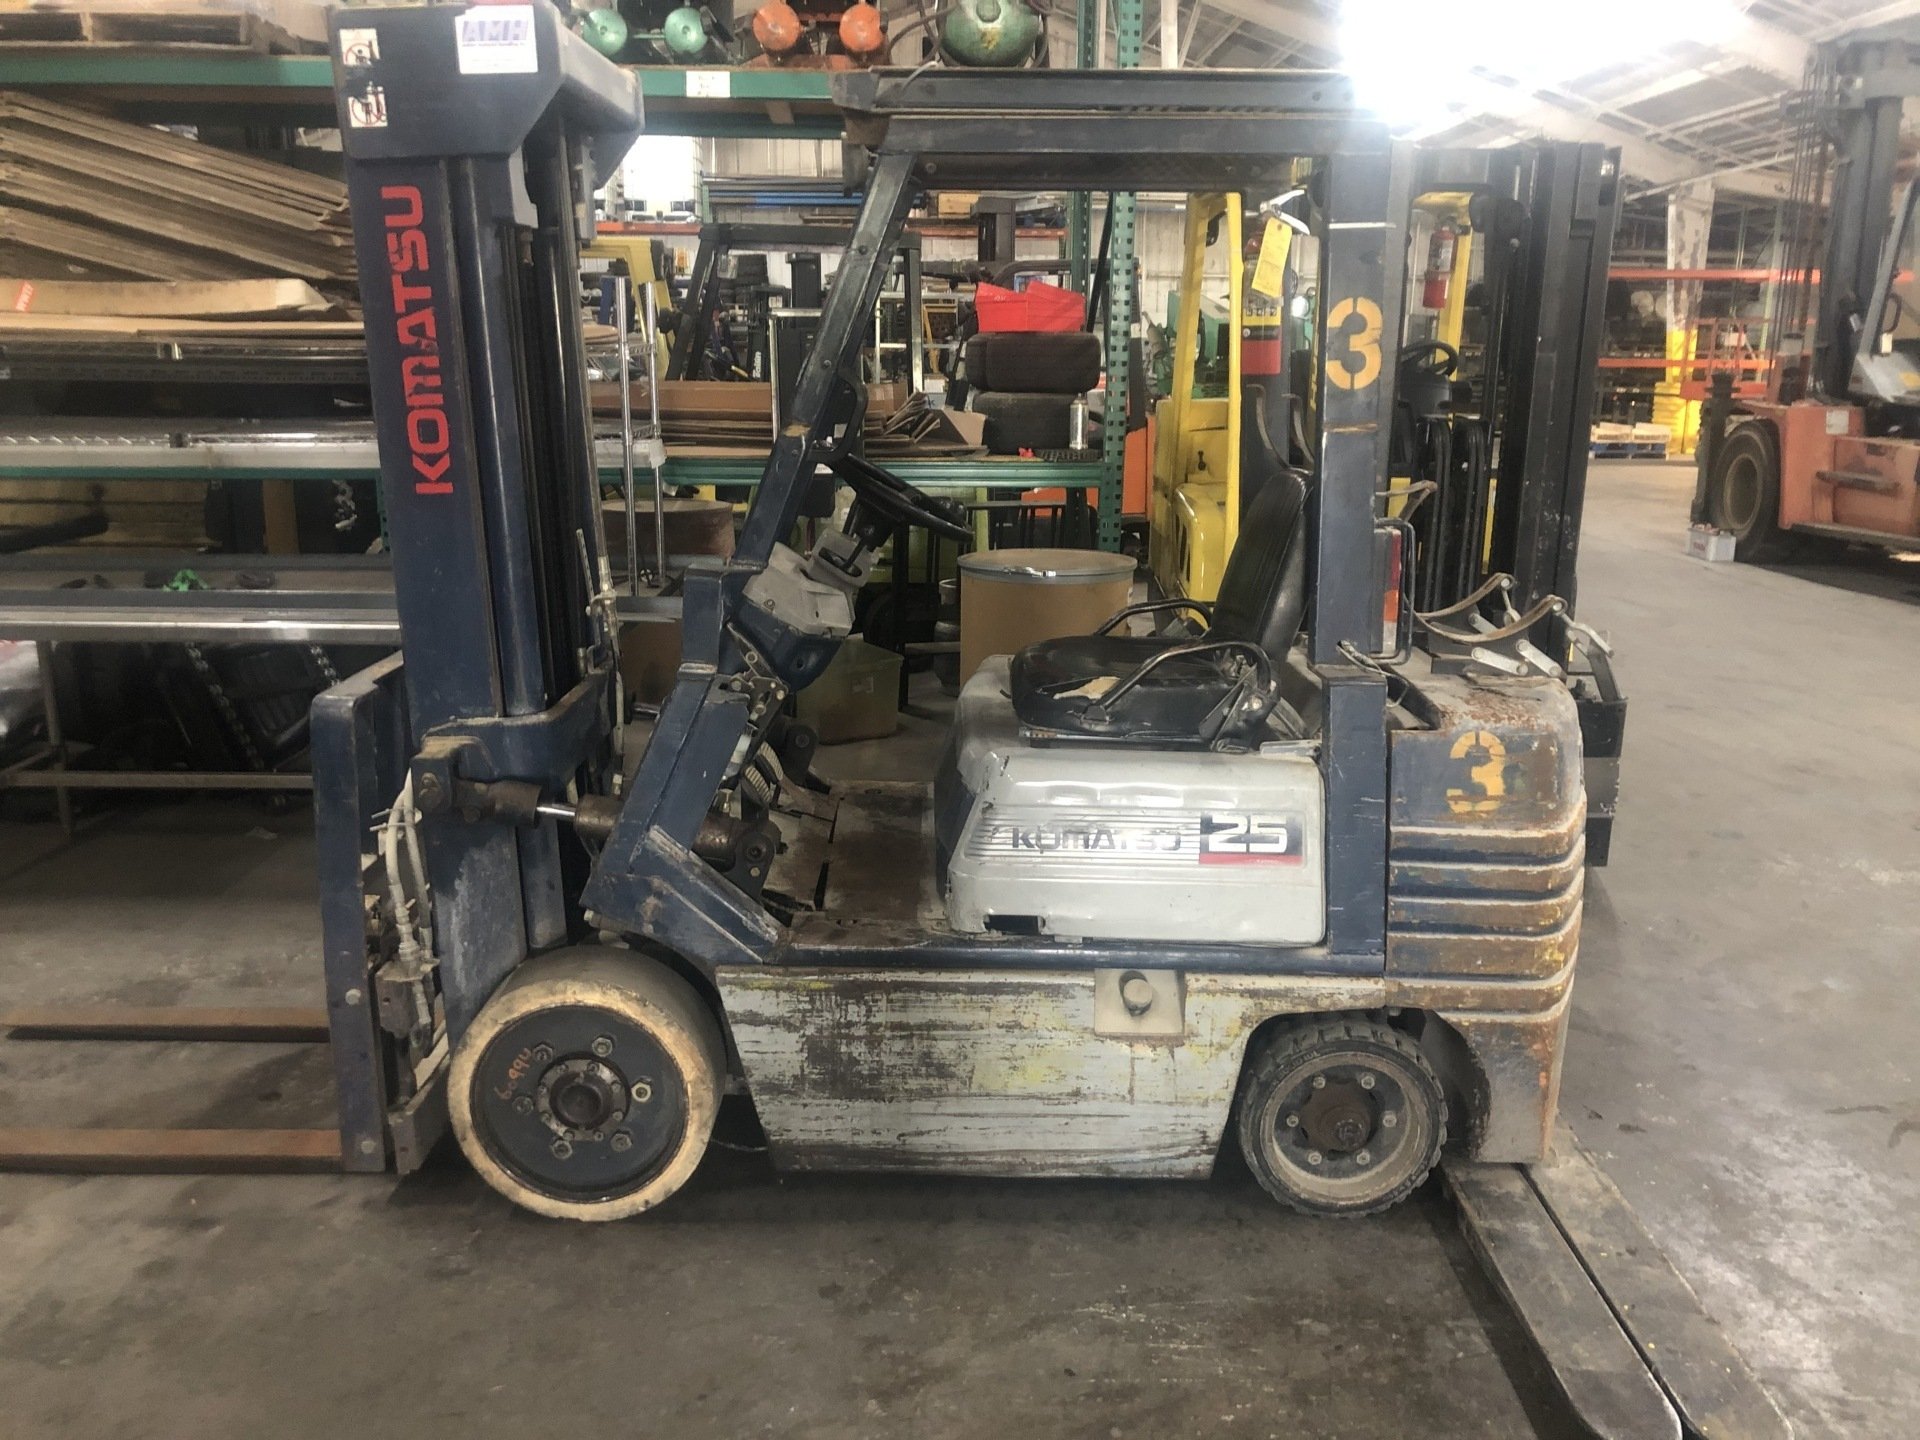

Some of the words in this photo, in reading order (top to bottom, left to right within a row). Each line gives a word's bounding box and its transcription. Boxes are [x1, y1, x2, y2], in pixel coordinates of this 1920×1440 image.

[380, 184, 454, 495] KOMATSU
[1325, 296, 1383, 390] 3
[1446, 730, 1506, 814] 3
[1208, 814, 1288, 853] 25
